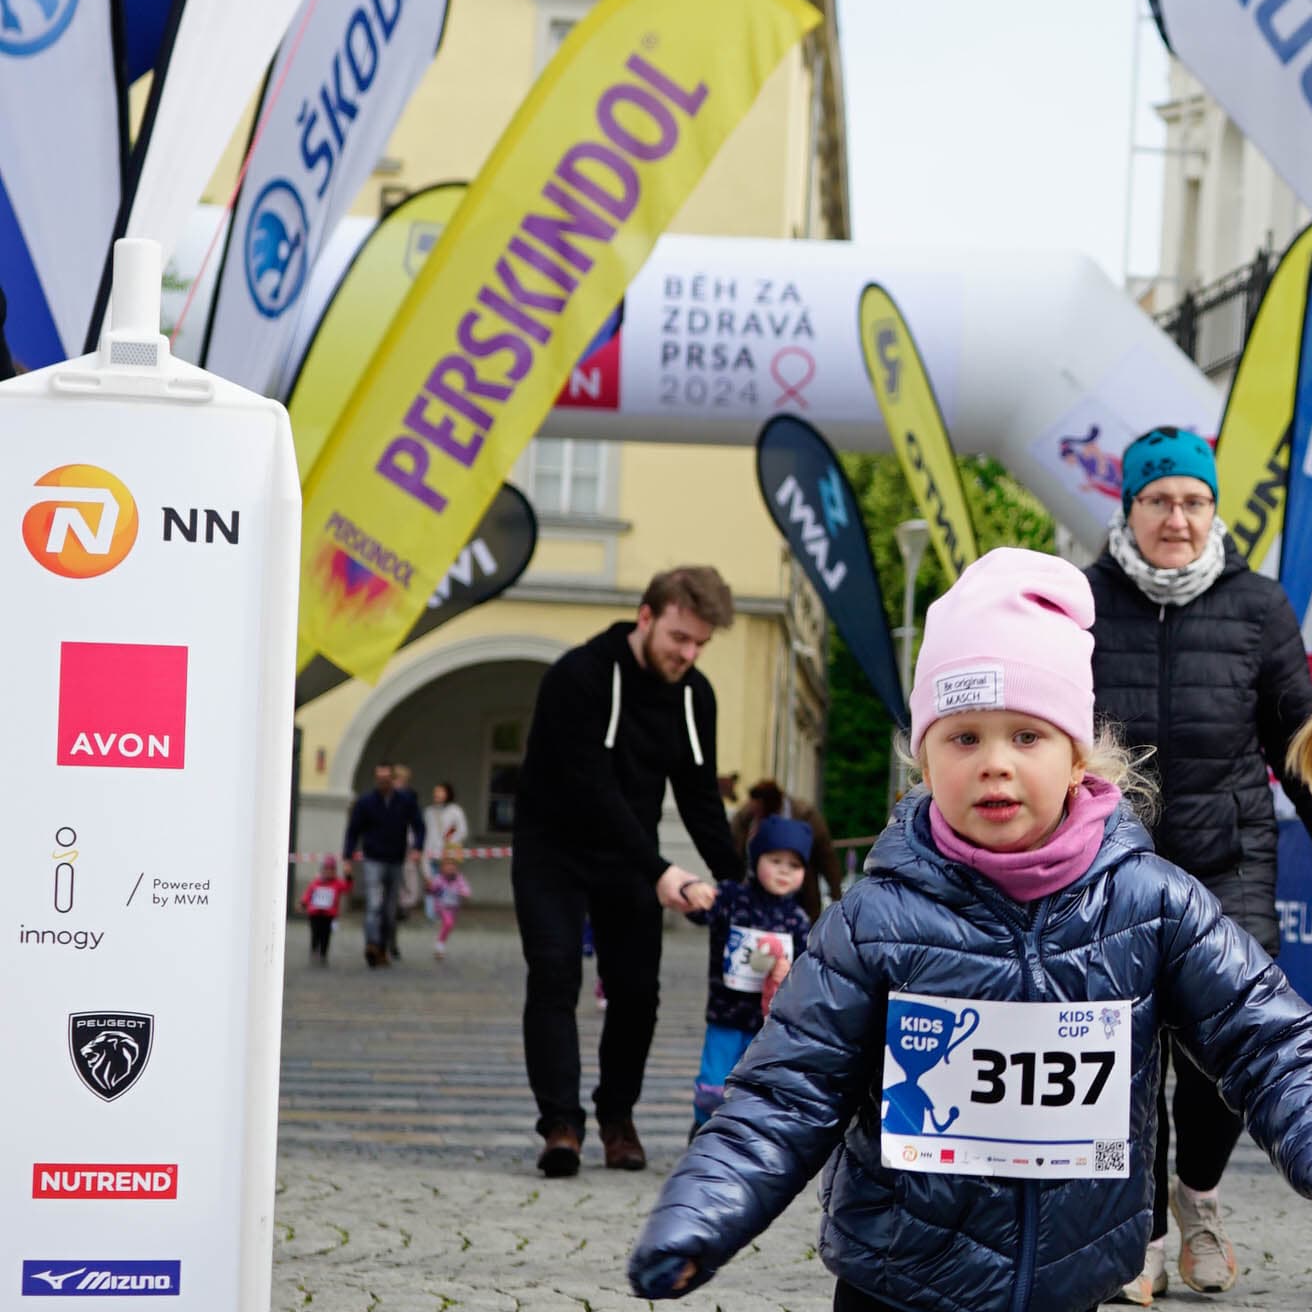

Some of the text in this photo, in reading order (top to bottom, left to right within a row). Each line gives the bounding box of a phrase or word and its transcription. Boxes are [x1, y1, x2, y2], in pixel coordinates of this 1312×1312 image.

[375, 53, 709, 515] PERSKINDOL
[756, 279, 802, 303] ZA
[662, 306, 815, 338] ZDRAVÁ
[661, 341, 755, 371] PRSA
[660, 376, 760, 407] 2024
[161, 506, 240, 545] NN
[70, 732, 170, 758] AVON
[153, 878, 211, 892] Powered
[153, 893, 209, 907] by MVM
[19, 925, 105, 950] innogy
[76, 1018, 146, 1030] PEUGEOT
[900, 1016, 944, 1034] KIDS
[1058, 1010, 1095, 1023] KIDS
[900, 1036, 939, 1052] CUP
[1058, 1026, 1090, 1038] CUP
[970, 1048, 1116, 1107] 3137
[40, 1171, 171, 1193] NUTREND
